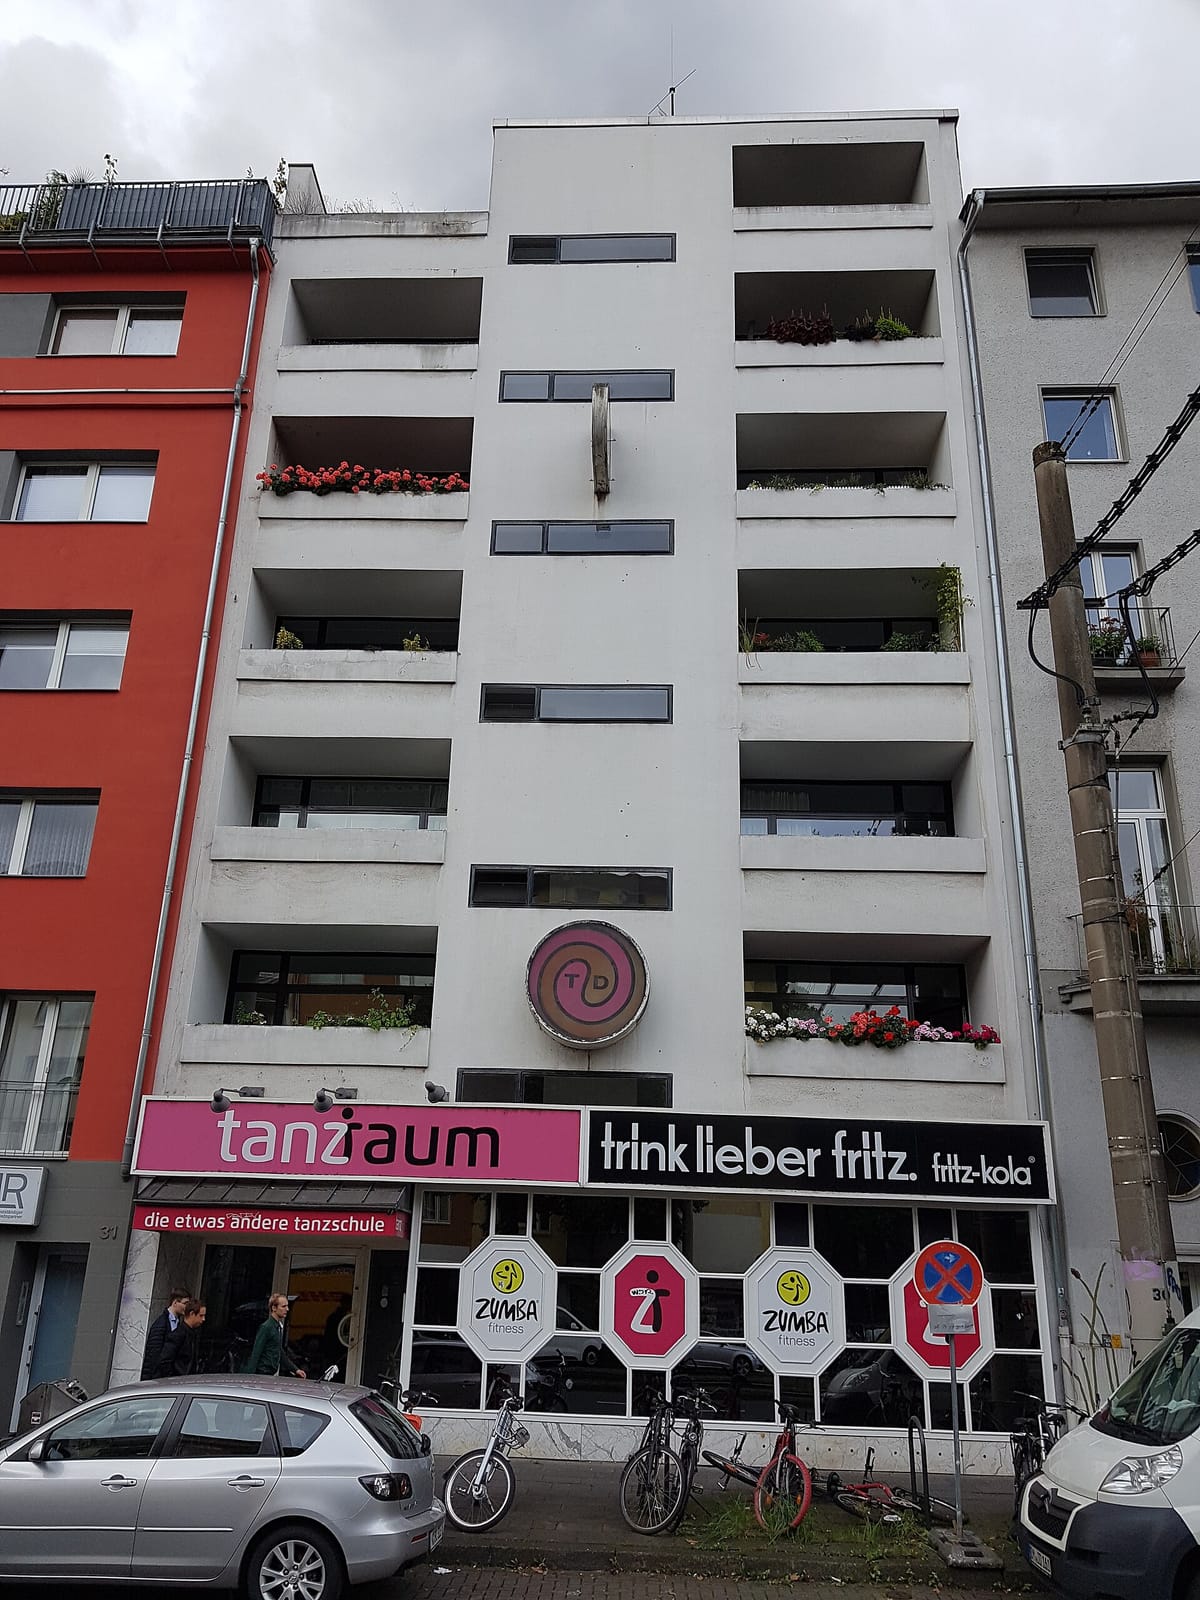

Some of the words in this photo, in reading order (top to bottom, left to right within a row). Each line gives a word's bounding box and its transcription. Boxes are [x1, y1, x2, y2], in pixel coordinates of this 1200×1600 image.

[600, 1121, 690, 1173] trink
[696, 1125, 821, 1177] lieber
[831, 1130, 918, 1181] fritz.
[144, 1212, 169, 1228] die
[174, 1215, 225, 1229] etwas
[230, 1215, 288, 1231] andere
[293, 1216, 385, 1232] tanzschule
[100, 1225, 119, 1240] 31
[475, 1297, 538, 1321] ZUMBA
[488, 1322, 524, 1334] fitness
[762, 1309, 829, 1334] ZUMBA
[778, 1335, 816, 1347] fitness
